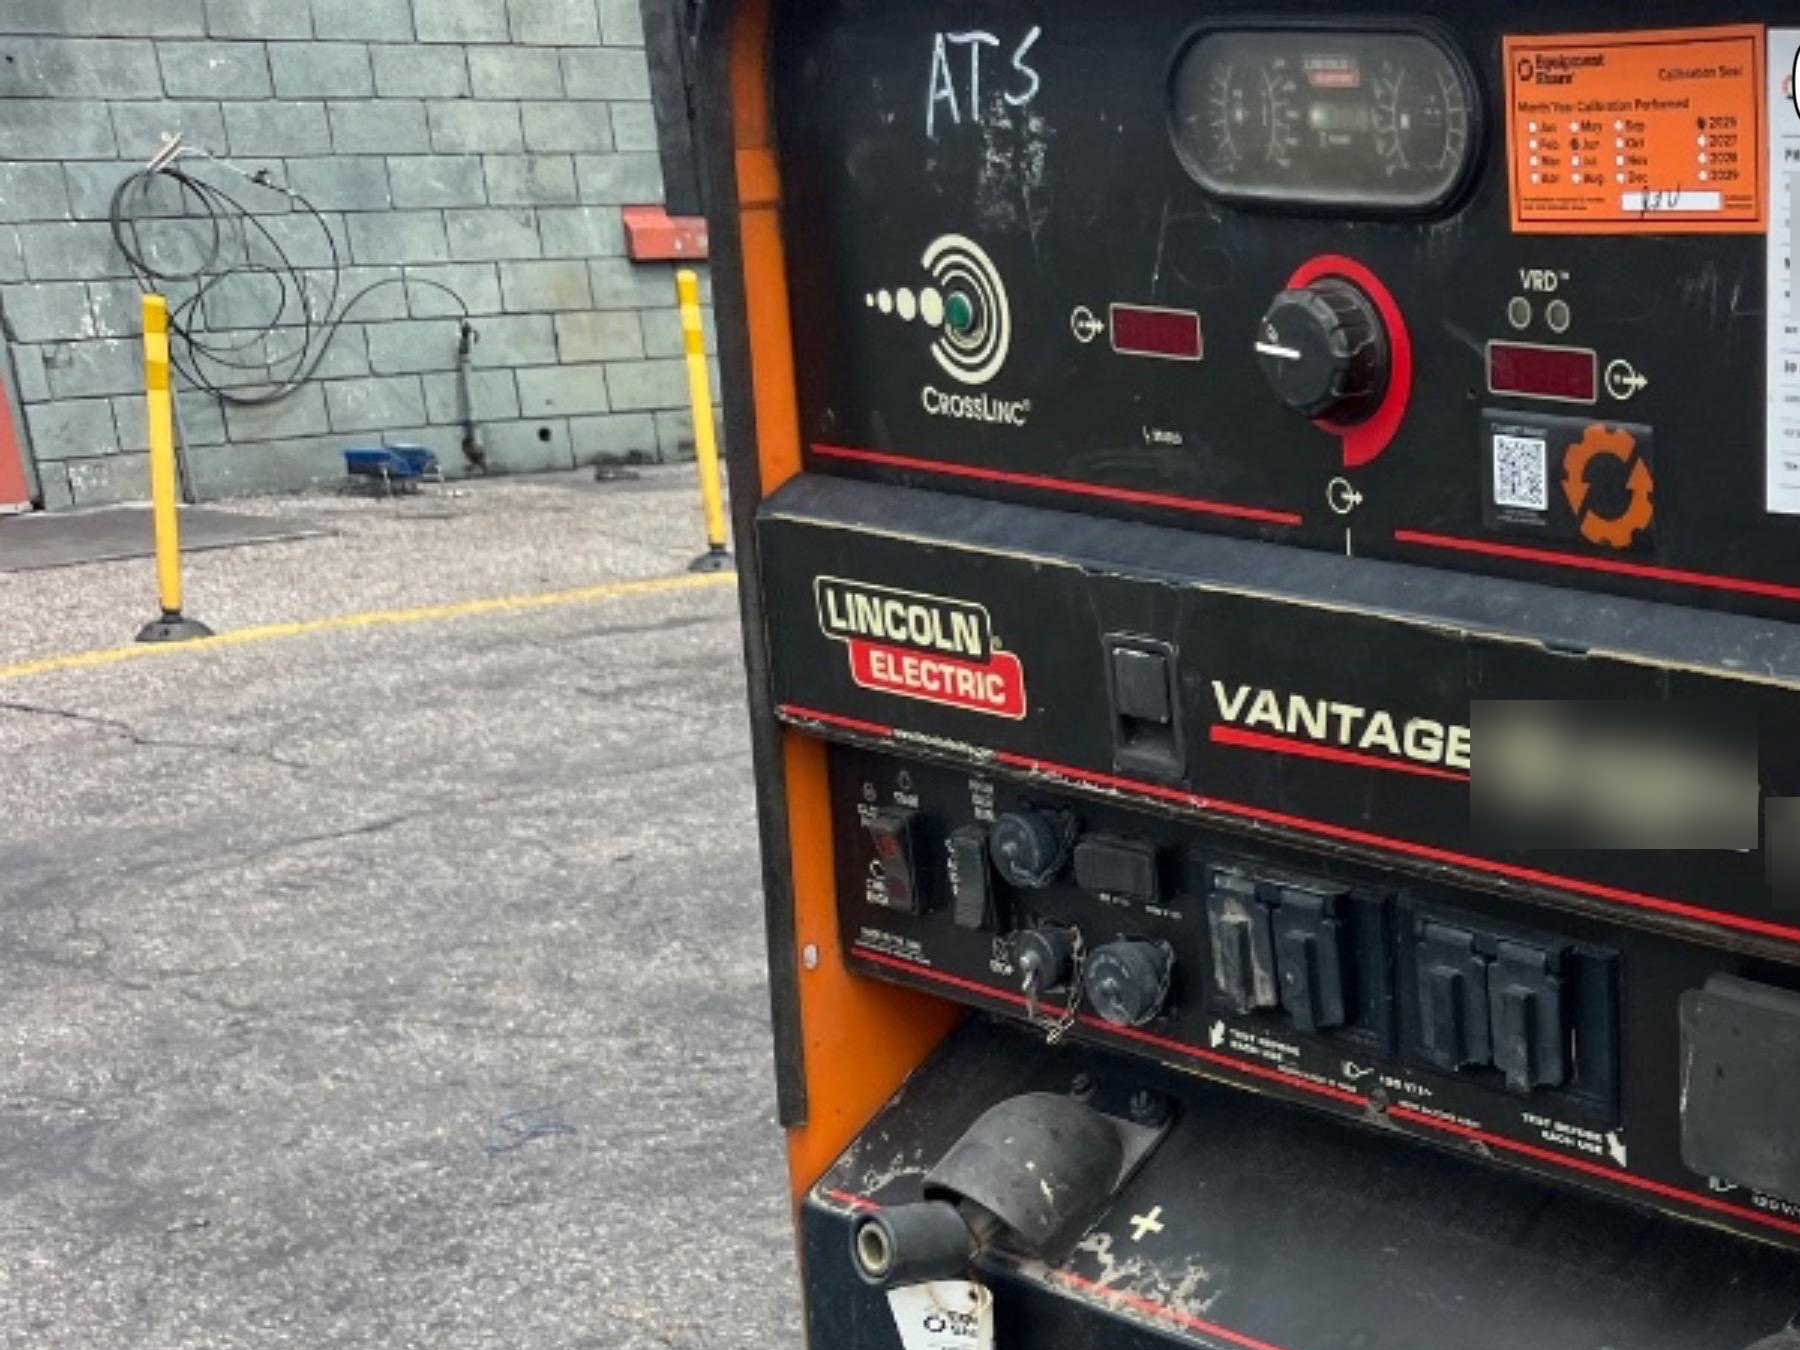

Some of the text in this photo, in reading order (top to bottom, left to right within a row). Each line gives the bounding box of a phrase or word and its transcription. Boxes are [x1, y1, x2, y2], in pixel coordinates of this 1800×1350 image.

[825, 588, 984, 658] LINCOLN
[867, 649, 1007, 706] ELECTRIC
[1211, 679, 1471, 769] VANTAGE
